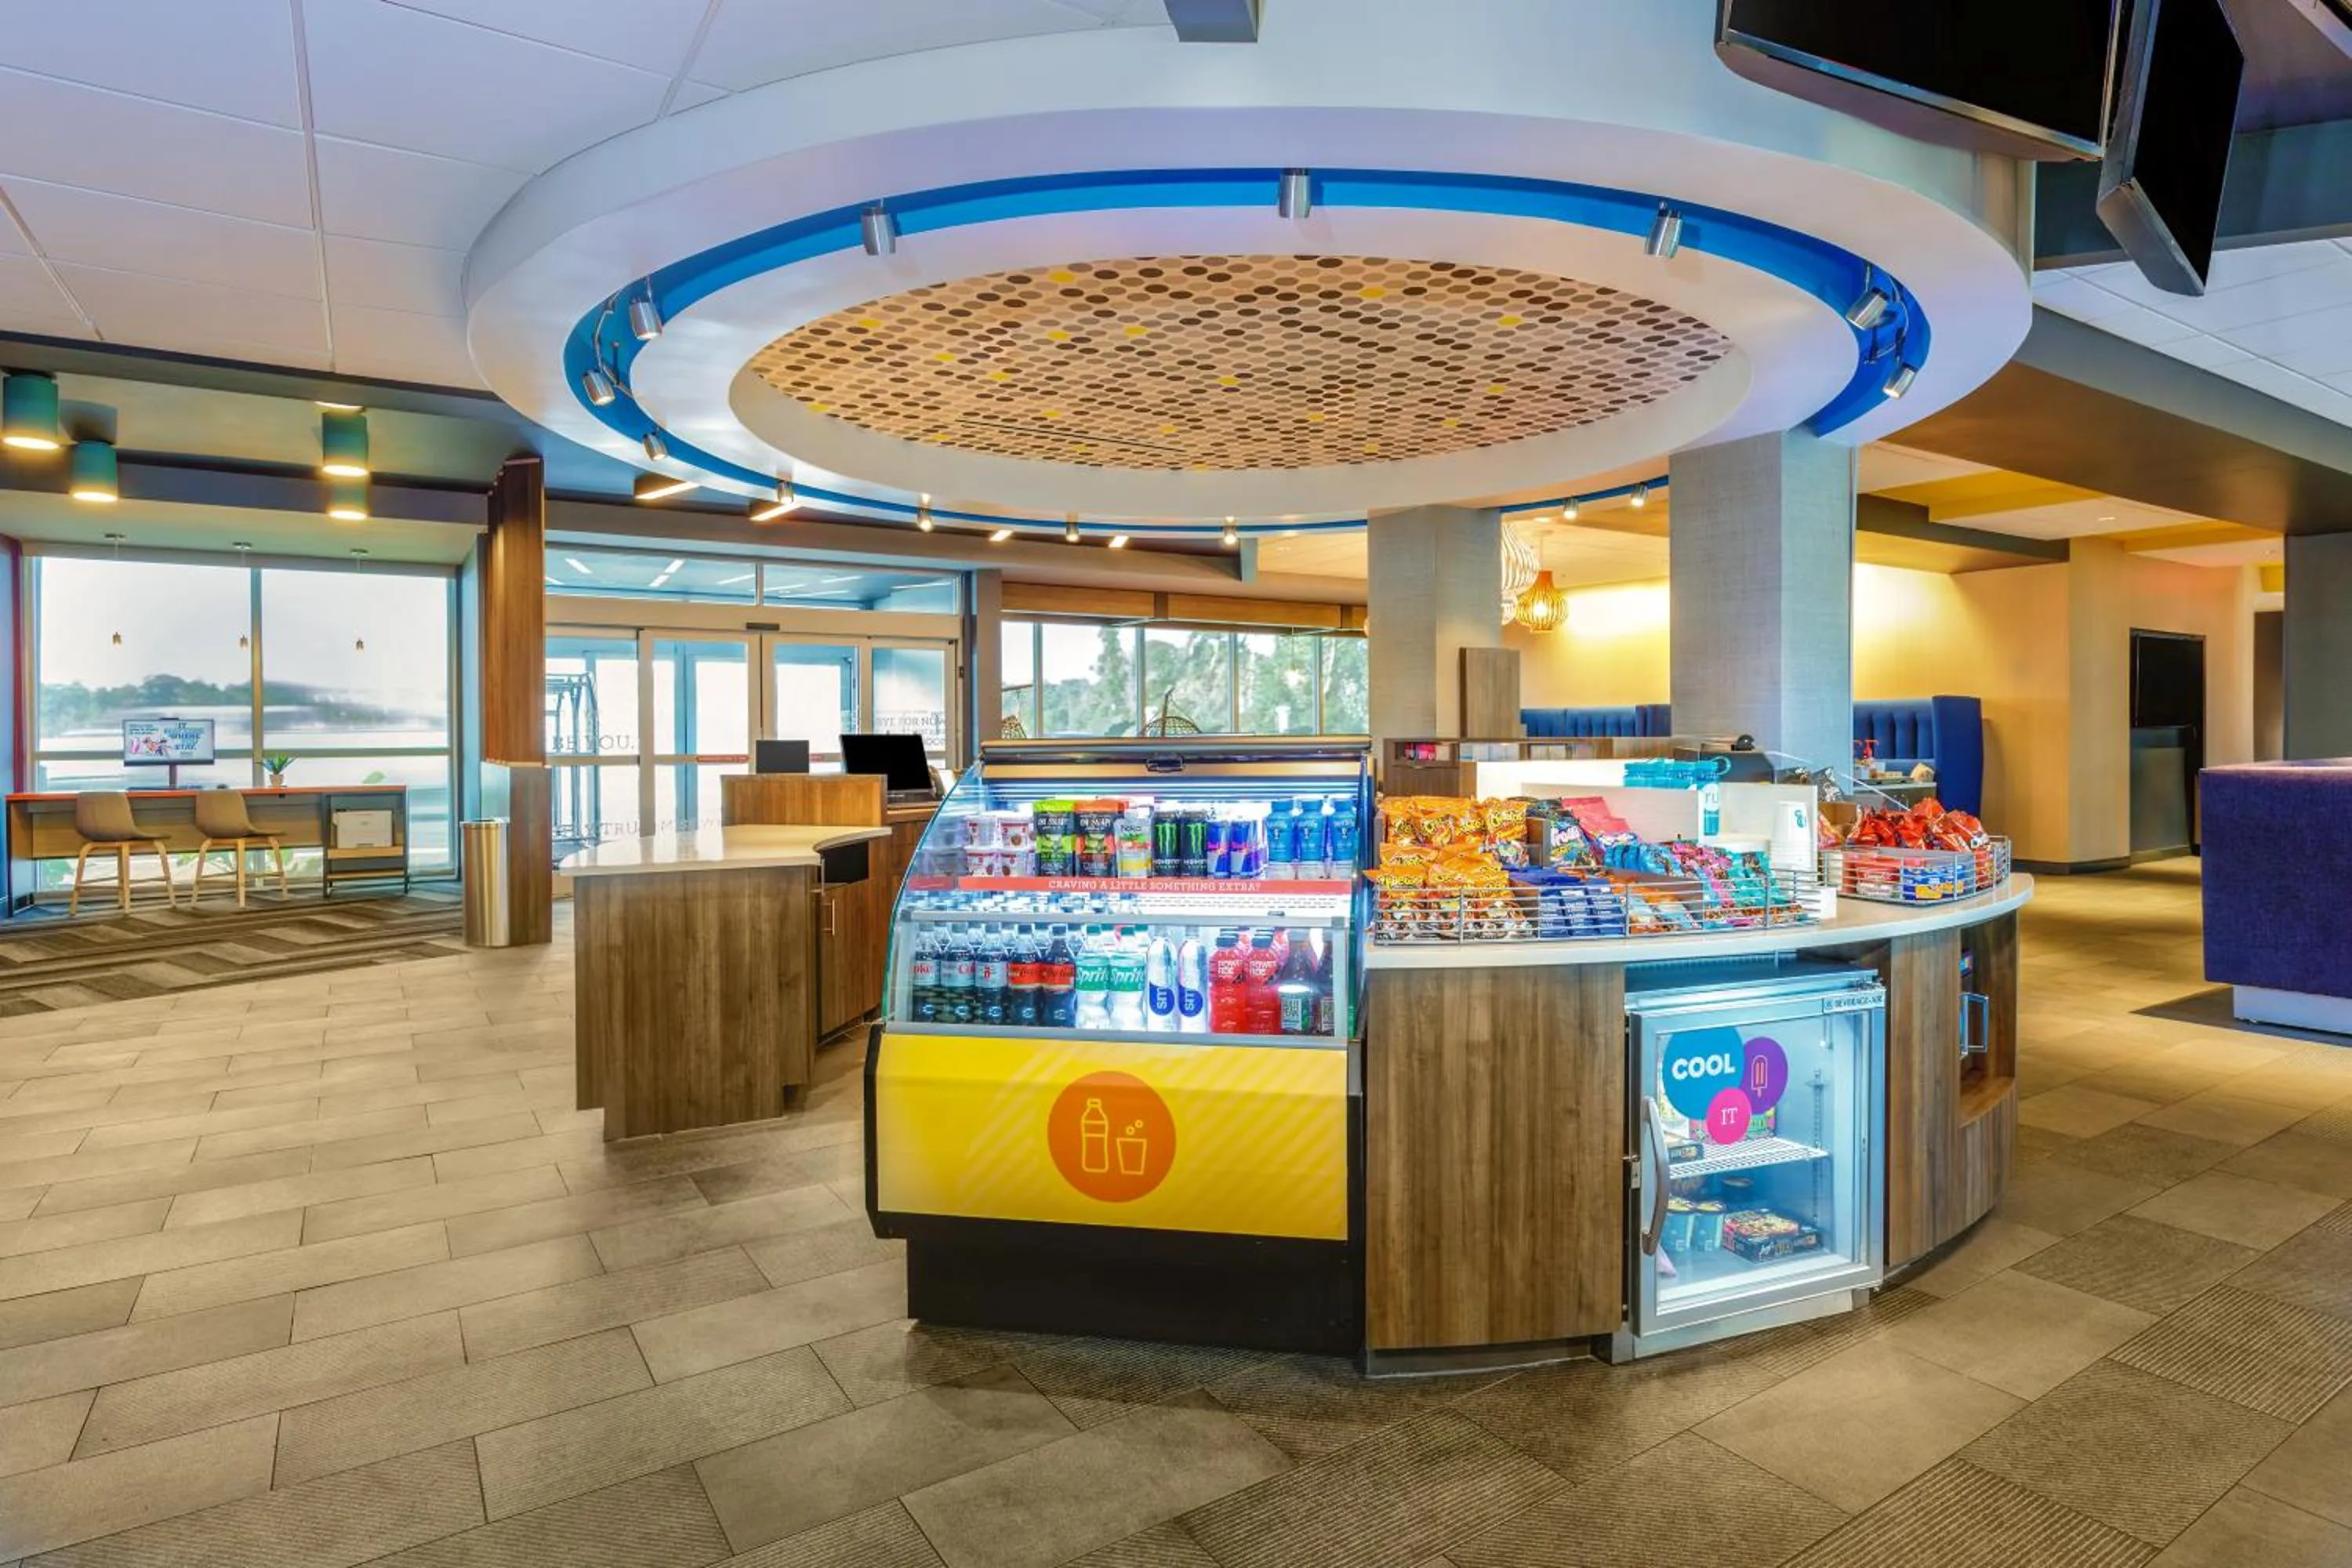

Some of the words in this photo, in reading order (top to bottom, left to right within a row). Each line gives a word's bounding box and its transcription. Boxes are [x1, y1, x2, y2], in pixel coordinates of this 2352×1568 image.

[1047, 880, 1097, 890] CRAVING
[1099, 880, 1108, 890] A
[1110, 880, 1146, 890] LITTLE
[1149, 881, 1215, 891] SOMETHING
[1671, 1053, 1736, 1080] COOL
[1721, 1107, 1737, 1125] IT
